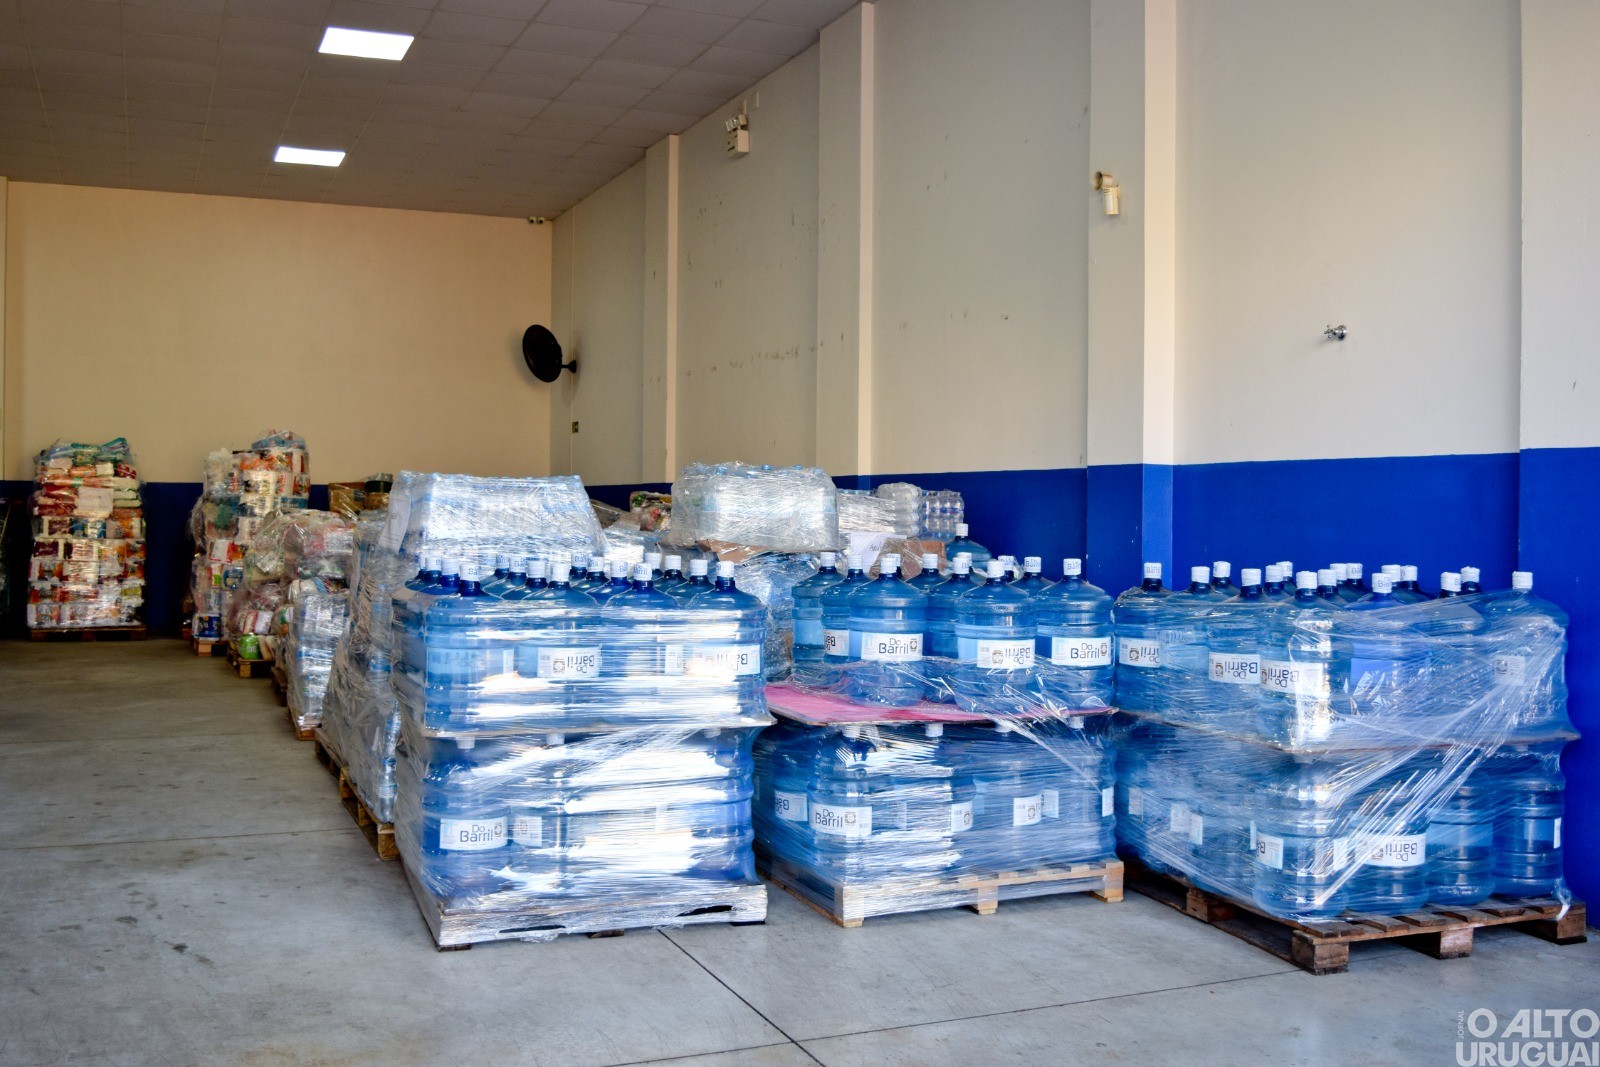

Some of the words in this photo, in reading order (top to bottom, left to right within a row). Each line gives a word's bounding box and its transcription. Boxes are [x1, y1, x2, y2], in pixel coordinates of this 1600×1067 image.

[889, 637, 901, 645] Do
[1081, 642, 1093, 651] Do
[878, 642, 909, 654] Barril
[1005, 647, 1031, 658] Barril
[1070, 647, 1100, 659] Barril
[567, 654, 595, 669] Barril
[1013, 654, 1024, 665] Do
[576, 664, 588, 674] Do
[1224, 661, 1258, 674] Barril
[1233, 670, 1247, 680] Do
[1267, 667, 1299, 682] Barril
[1275, 678, 1288, 688] Do
[822, 808, 835, 818] Do
[815, 811, 843, 828] Barril
[471, 824, 486, 833] Do
[459, 829, 493, 843] Barril
[1385, 842, 1418, 856] Barril
[1395, 852, 1409, 862] Do
